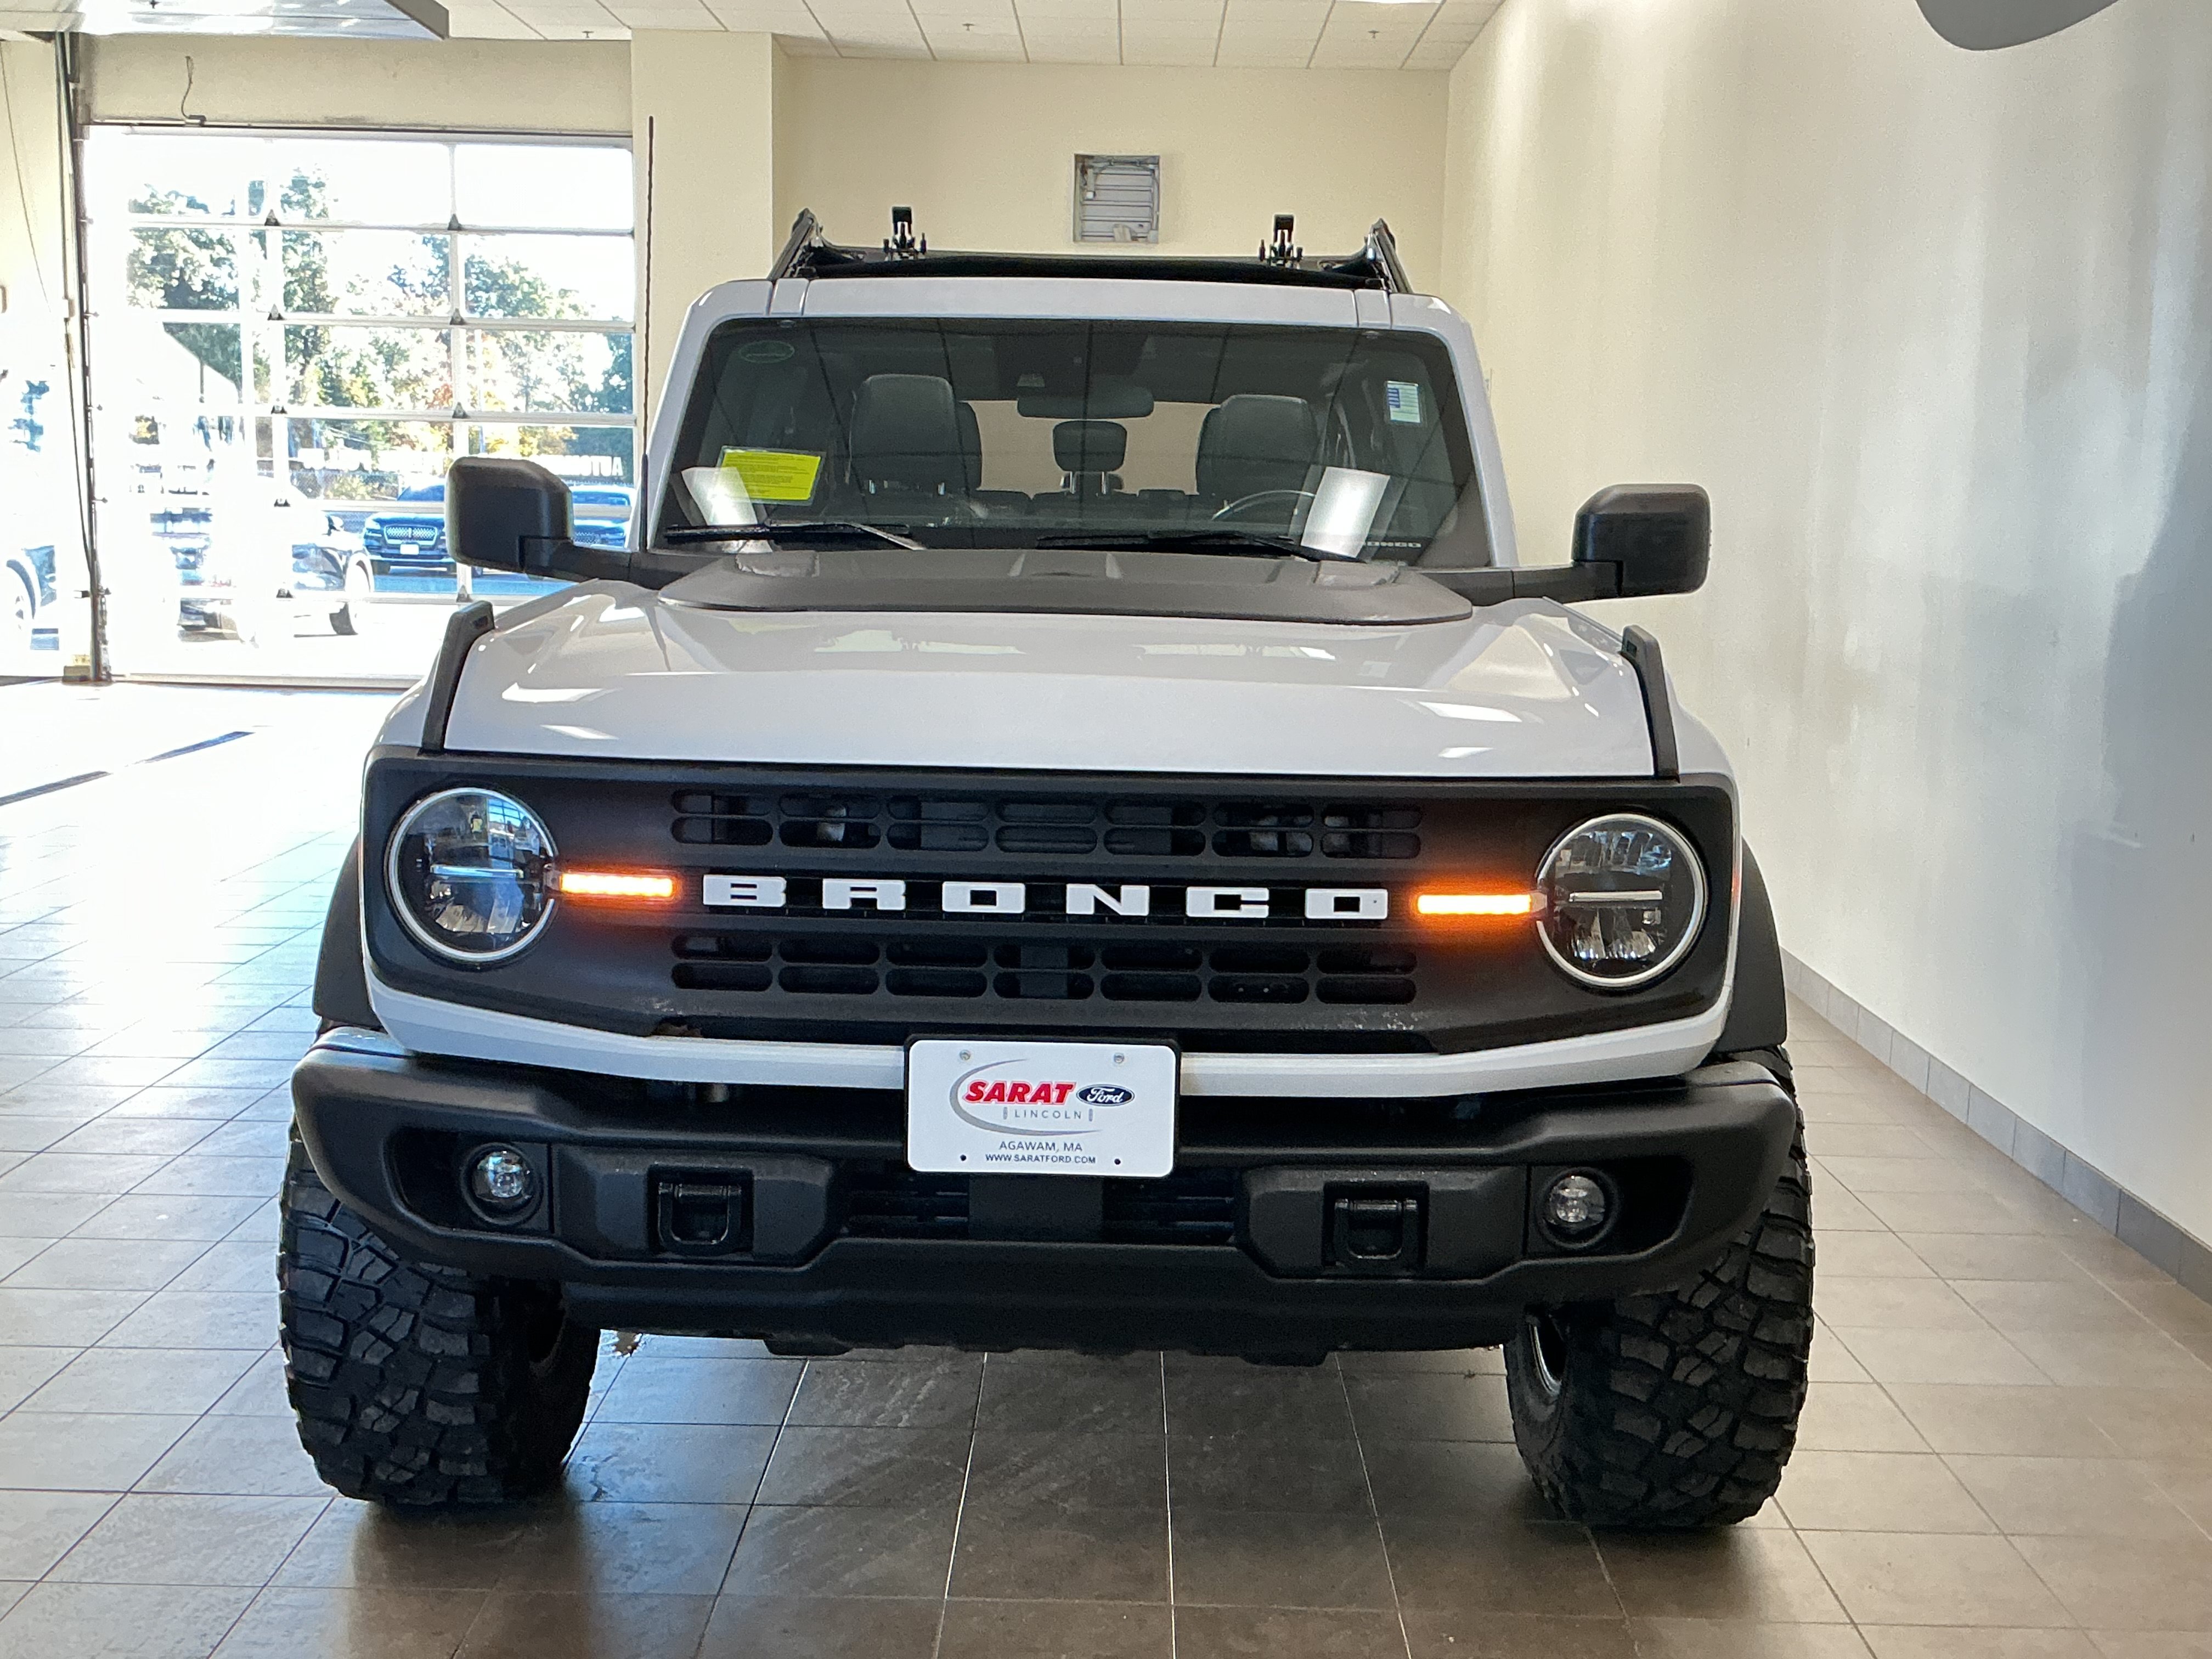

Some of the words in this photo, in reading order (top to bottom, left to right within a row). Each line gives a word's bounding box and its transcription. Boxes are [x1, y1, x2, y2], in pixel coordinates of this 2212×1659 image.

[702, 874, 1389, 920] BRONCO
[964, 1080, 1075, 1105] SARAT
[1086, 1086, 1124, 1104] Ford
[1014, 1109, 1082, 1120] LINCOLN
[998, 1140, 1059, 1153] AGAWAM,
[1063, 1142, 1083, 1152] MA
[985, 1153, 1096, 1164] WWW.SARATFORD.COM
